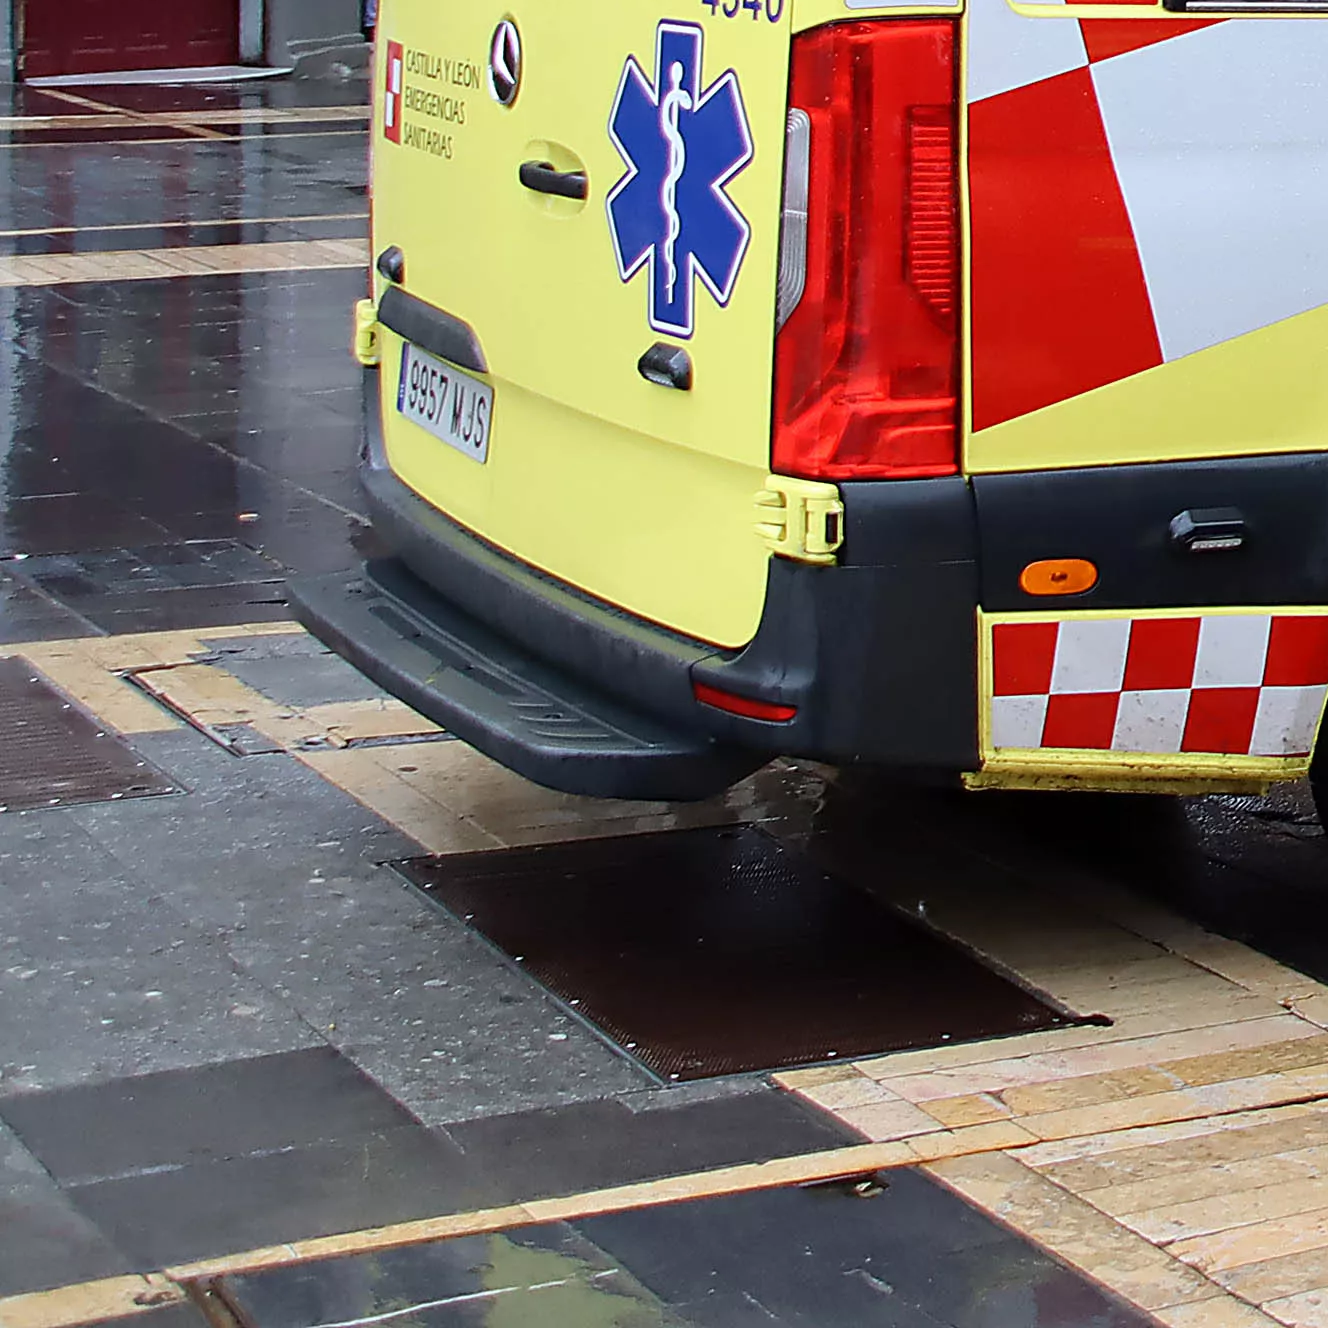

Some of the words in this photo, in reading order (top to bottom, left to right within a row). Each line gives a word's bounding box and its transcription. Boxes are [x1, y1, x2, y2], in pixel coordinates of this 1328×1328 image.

[406, 49, 443, 81] CASTILLA
[443, 58, 452, 83] Y
[452, 58, 482, 90] LEÓN
[405, 84, 466, 125] EMERGENCIAS
[403, 121, 453, 160] SANITARIAS
[408, 359, 449, 425] 9957
[450, 381, 487, 449] MJS
